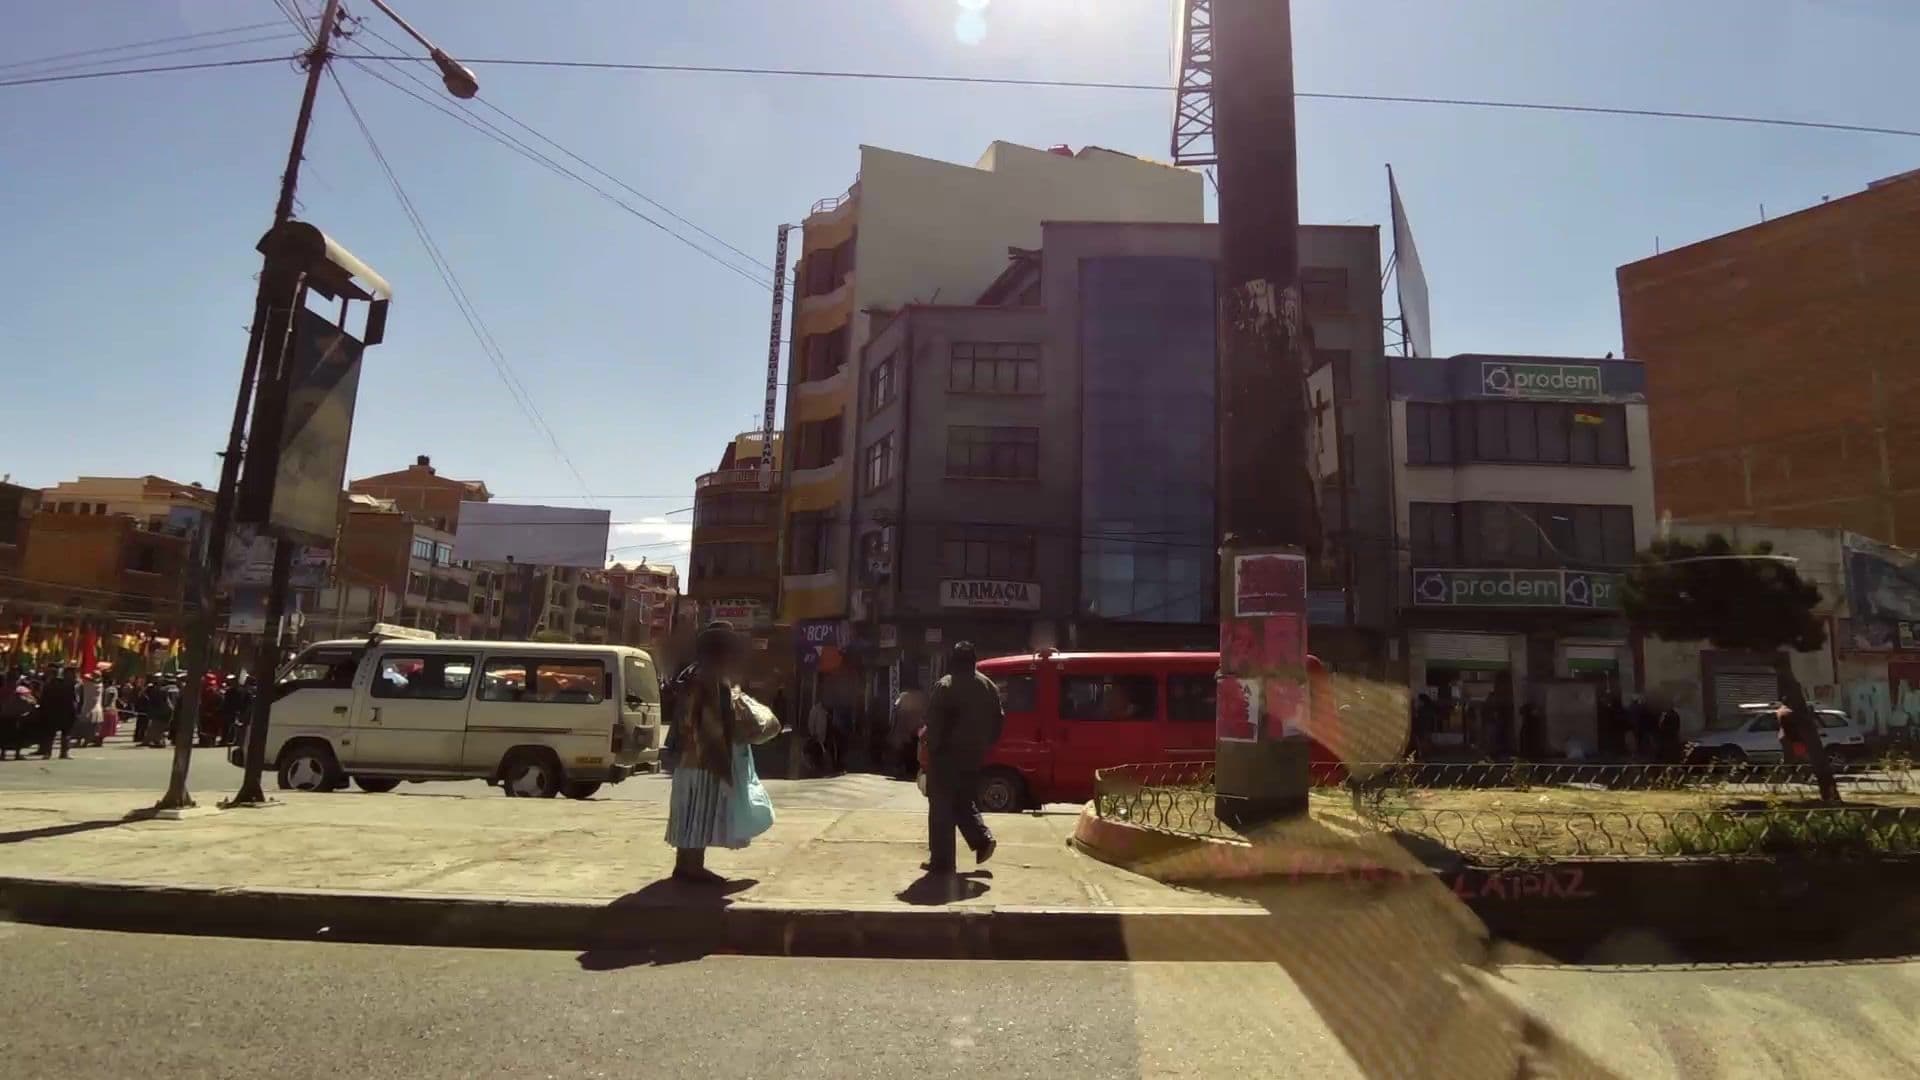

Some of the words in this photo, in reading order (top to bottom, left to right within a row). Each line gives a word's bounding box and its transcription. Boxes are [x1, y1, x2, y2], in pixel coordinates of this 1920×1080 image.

[1513, 366, 1597, 396] prodem
[950, 582, 1029, 601] FARMACIA
[1451, 571, 1558, 605] prodem
